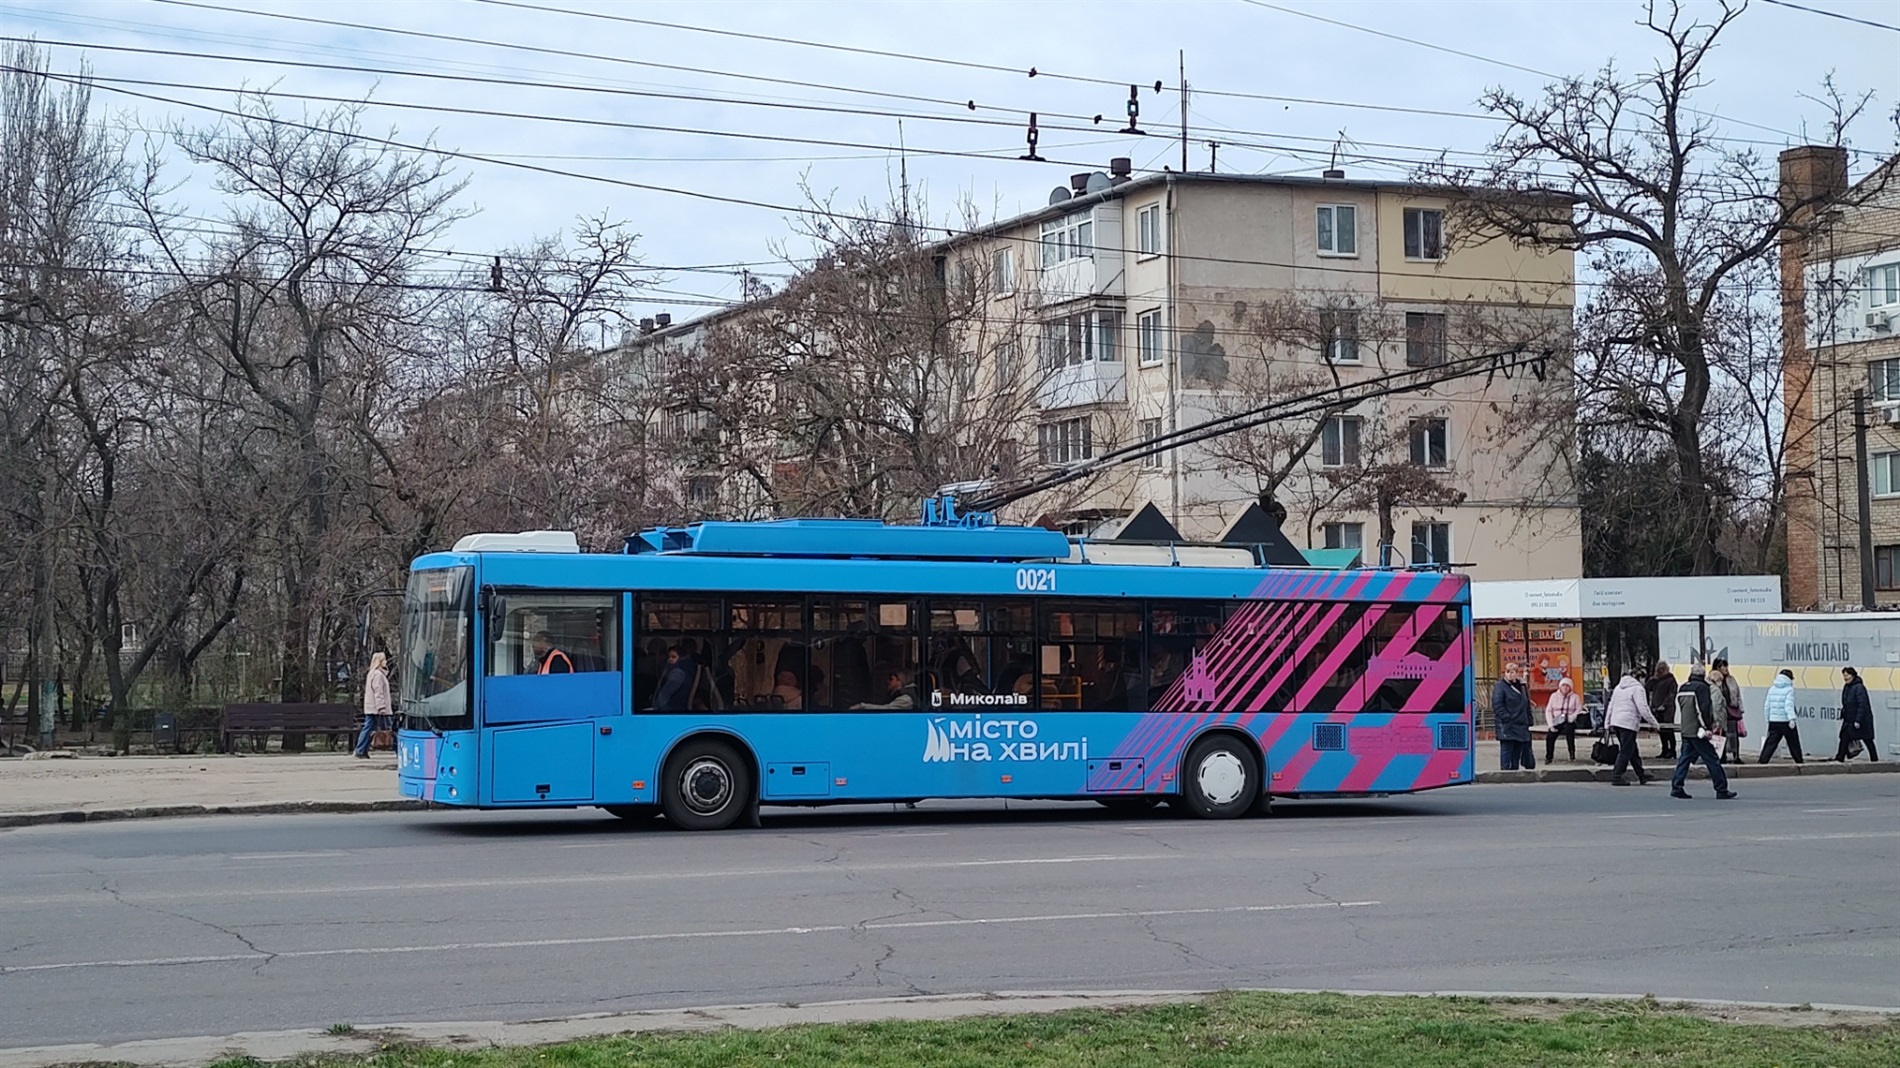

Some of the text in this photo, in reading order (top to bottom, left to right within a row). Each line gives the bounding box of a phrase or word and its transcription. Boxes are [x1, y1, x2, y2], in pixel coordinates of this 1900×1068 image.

[1016, 568, 1056, 591] 0021
[1756, 623, 1799, 637] УКРИТТЯ
[950, 692, 1028, 705] Миколаїв
[950, 714, 1038, 739] місто
[950, 737, 1087, 761] на хвилі
